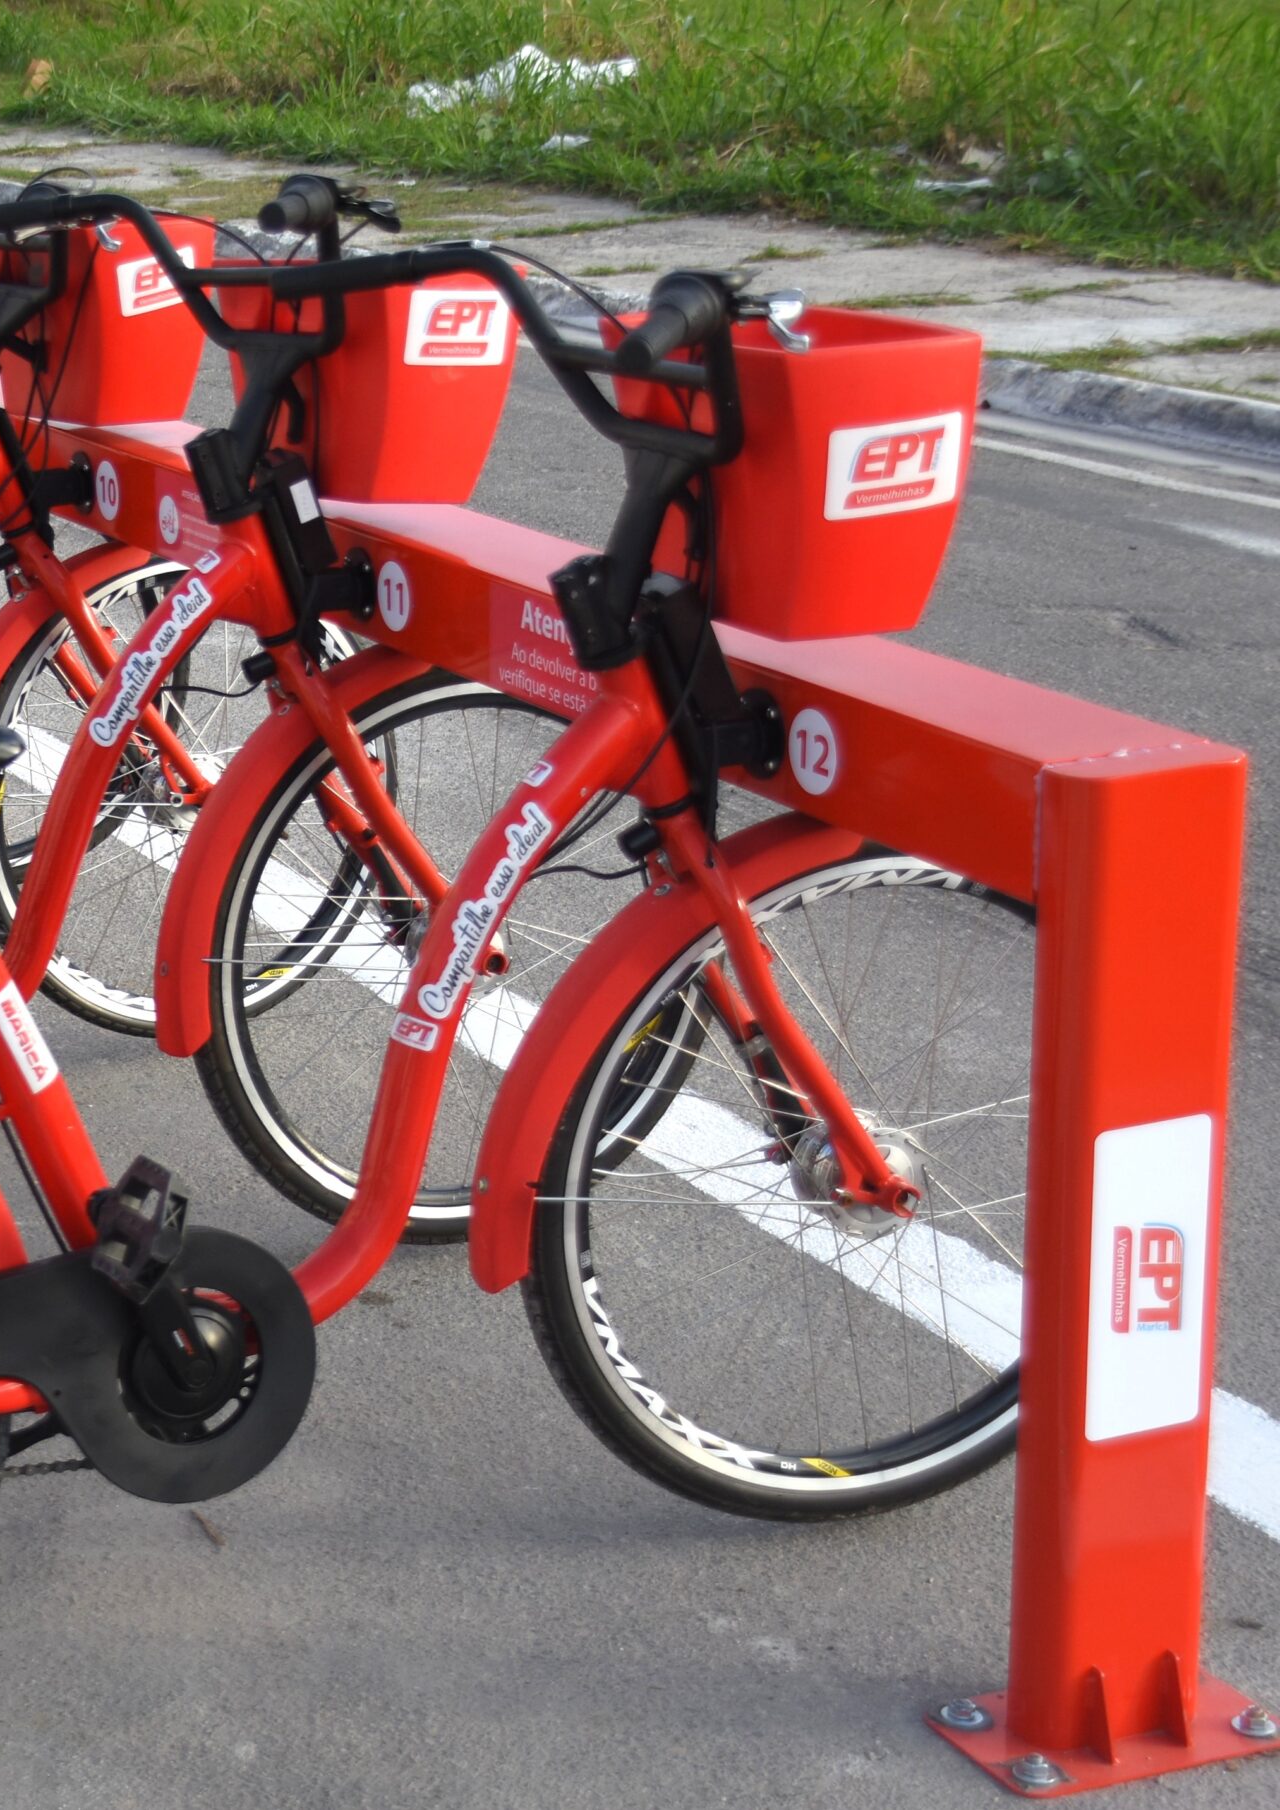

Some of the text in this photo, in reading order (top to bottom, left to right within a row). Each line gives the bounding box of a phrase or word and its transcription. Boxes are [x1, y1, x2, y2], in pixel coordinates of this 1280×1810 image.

[426, 300, 497, 336] EPT
[851, 426, 945, 484] EPT
[99, 475, 116, 506] 10
[855, 486, 926, 504] Vermelhinhas
[383, 578, 404, 616] 11
[95, 653, 156, 742] Compartilhe
[158, 624, 176, 652] essa
[512, 642, 526, 664] Ao
[528, 649, 578, 683] devolver
[580, 673, 586, 686] a
[499, 666, 586, 712] verifique se está
[795, 728, 830, 776] 12
[423, 903, 493, 1013] Compartilhe
[492, 863, 514, 898] essa
[394, 1018, 434, 1043] EPT
[1114, 1238, 1129, 1324] Vermelhinhas
[1138, 1227, 1183, 1331] EPT
[582, 1276, 774, 1469] VMAXX
[780, 1461, 797, 1471] DH
